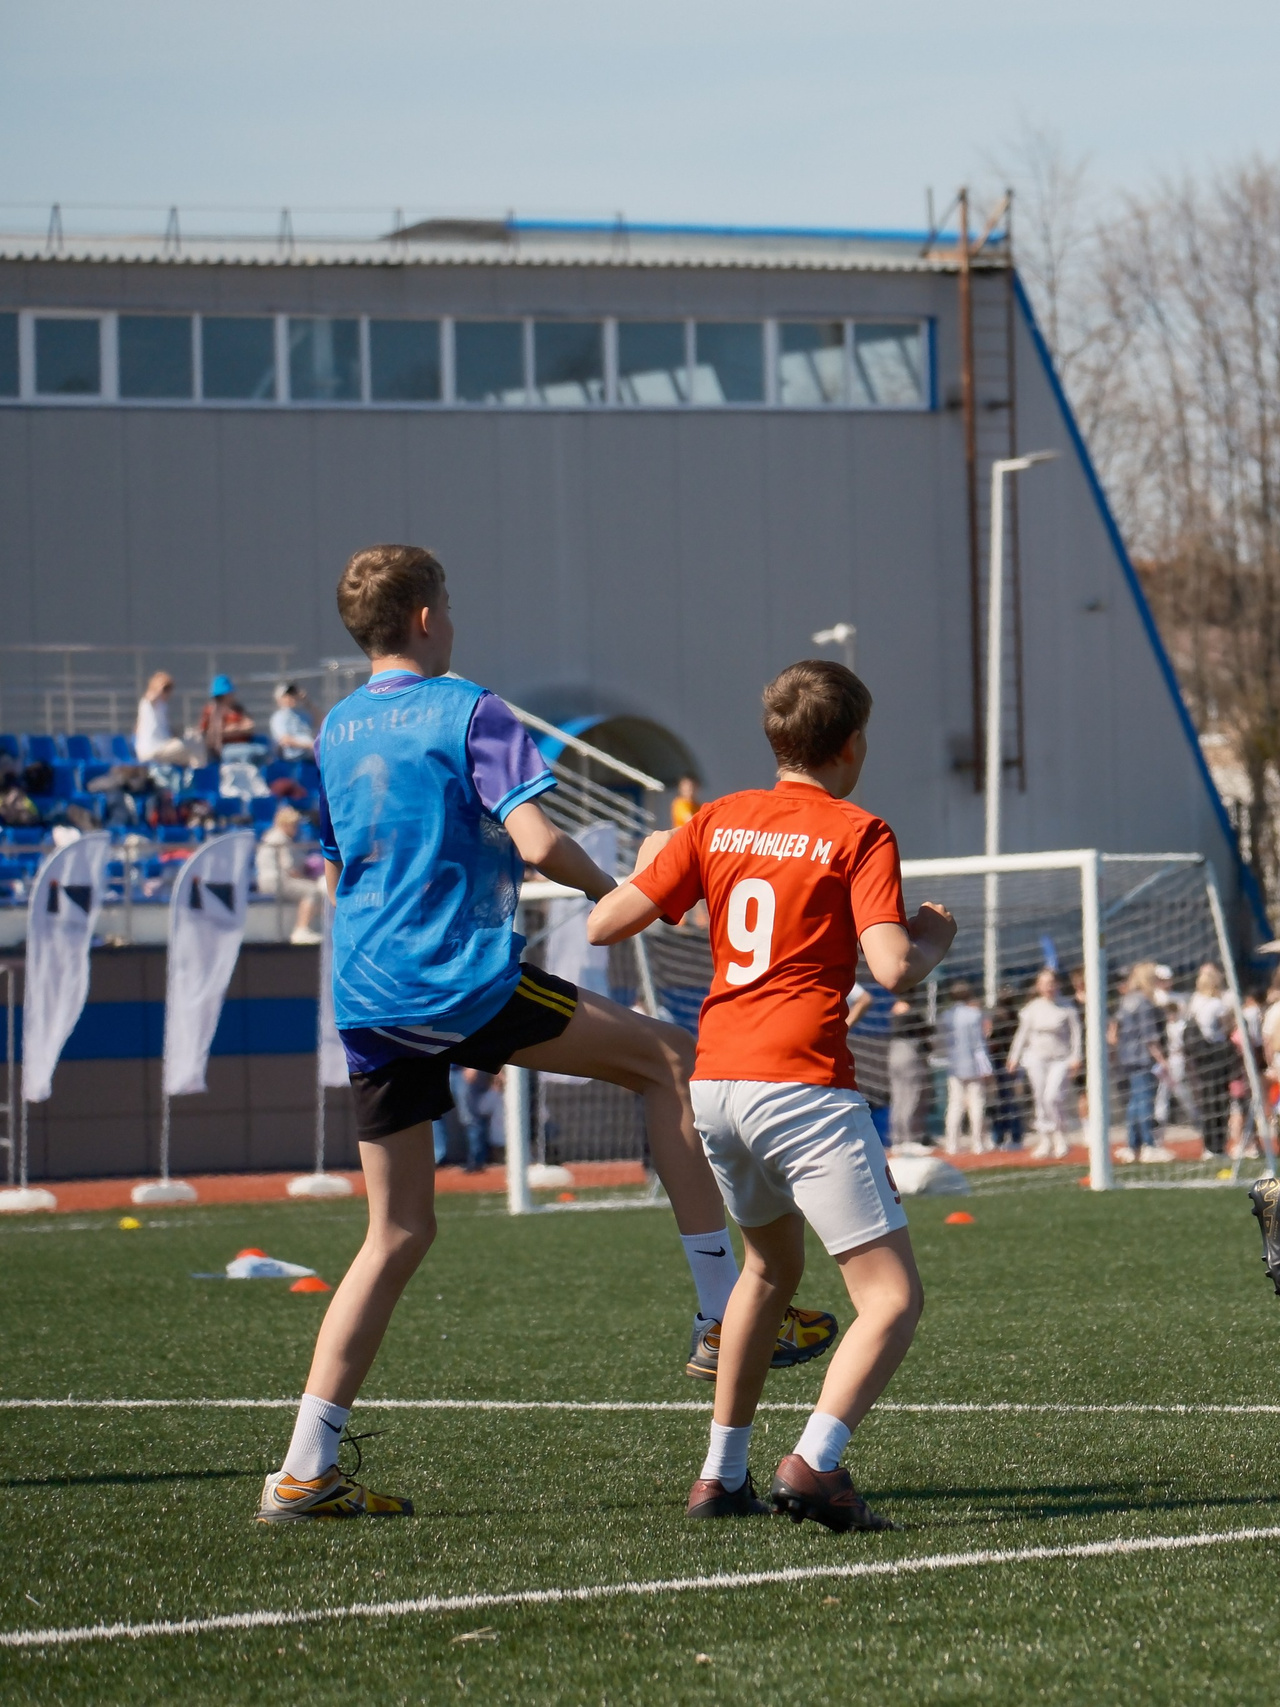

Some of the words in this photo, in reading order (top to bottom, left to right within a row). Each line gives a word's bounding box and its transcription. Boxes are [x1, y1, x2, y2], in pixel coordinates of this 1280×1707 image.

[709, 828, 810, 861] БОЯРИНЦЕВ
[810, 838, 833, 865] М.
[725, 877, 776, 986] 9
